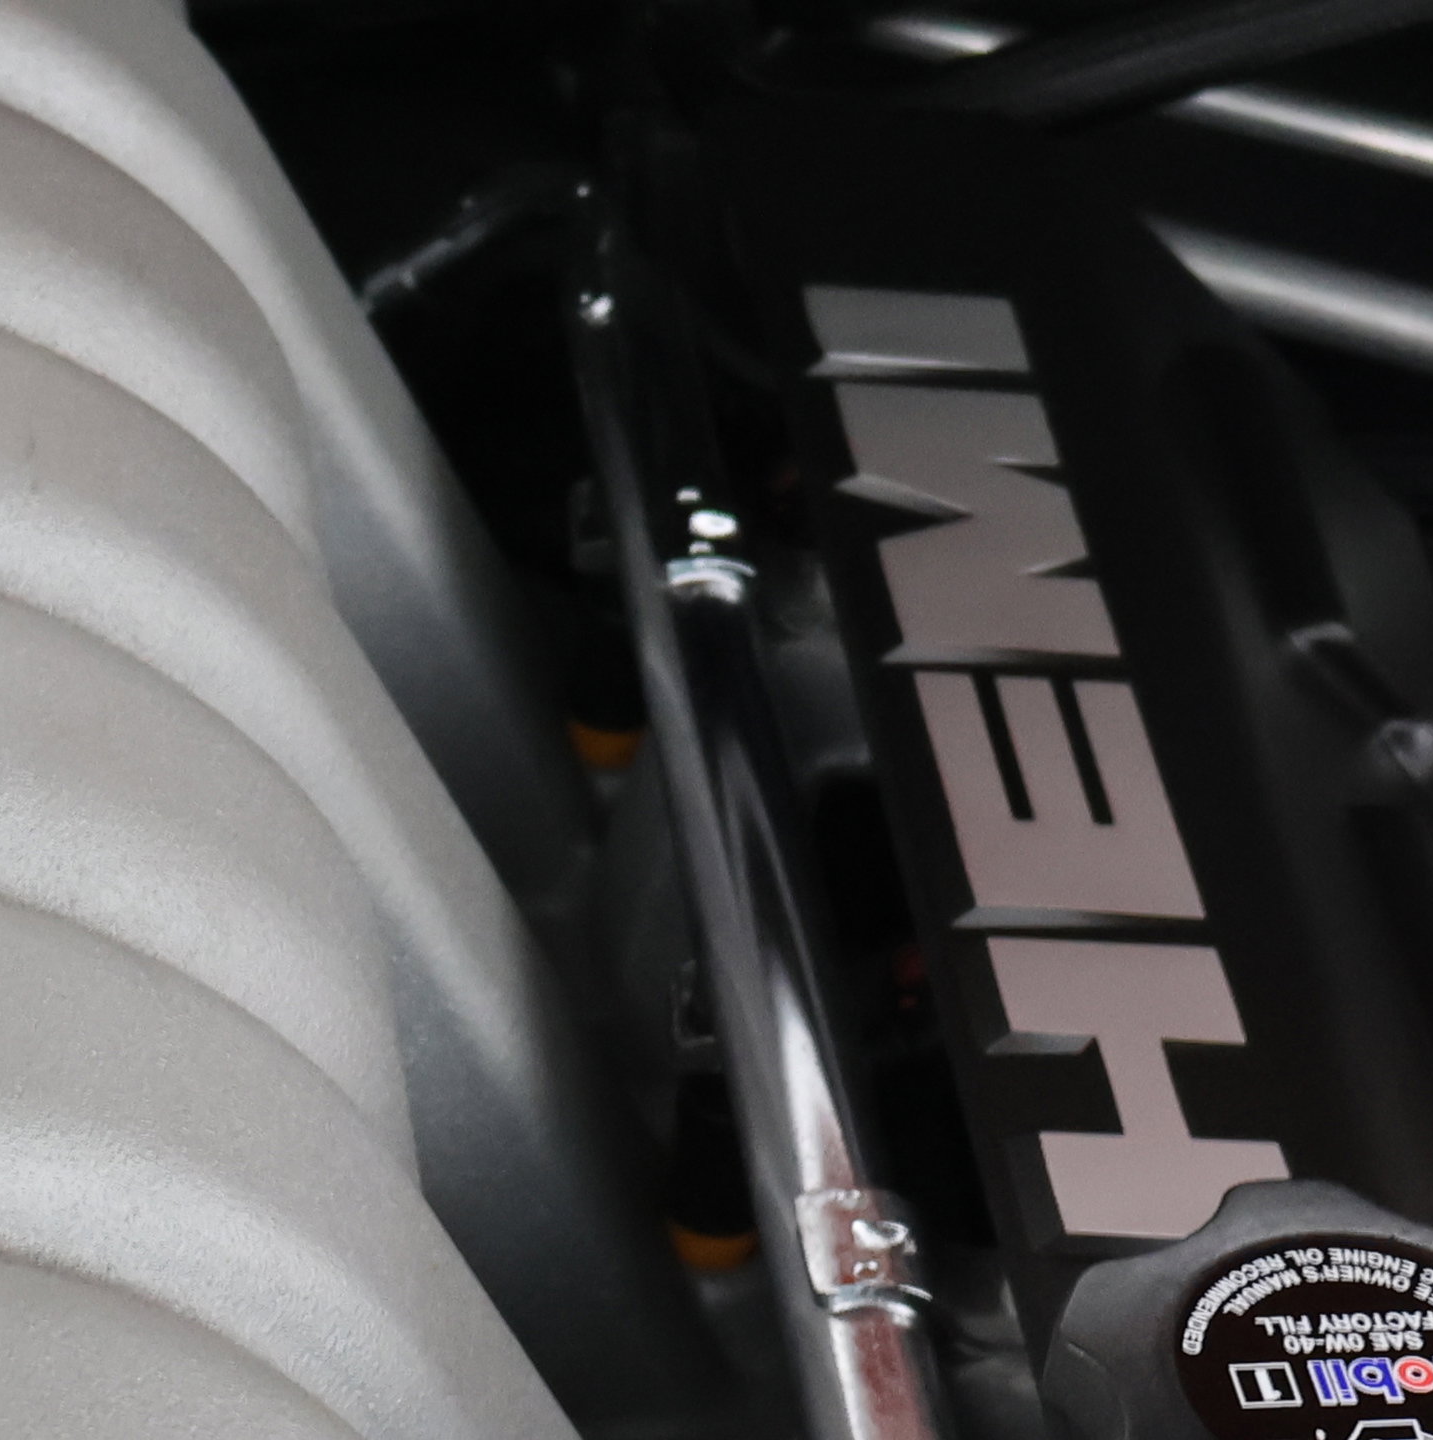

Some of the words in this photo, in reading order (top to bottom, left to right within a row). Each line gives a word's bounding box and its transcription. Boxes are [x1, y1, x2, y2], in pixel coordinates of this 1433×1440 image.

[803, 284, 1291, 1238] HEMI
[1285, 1247, 1324, 1262] OIL
[1327, 1247, 1417, 1277] ENGINE
[1222, 1268, 1301, 1317] MANUAL
[1305, 1264, 1411, 1293] OWNER'S
[1181, 1252, 1287, 1356] RECOMMENDED
[1254, 1315, 1308, 1336] FILL
[1283, 1332, 1366, 1354] 0W-40
[1370, 1331, 1425, 1352] SAE
